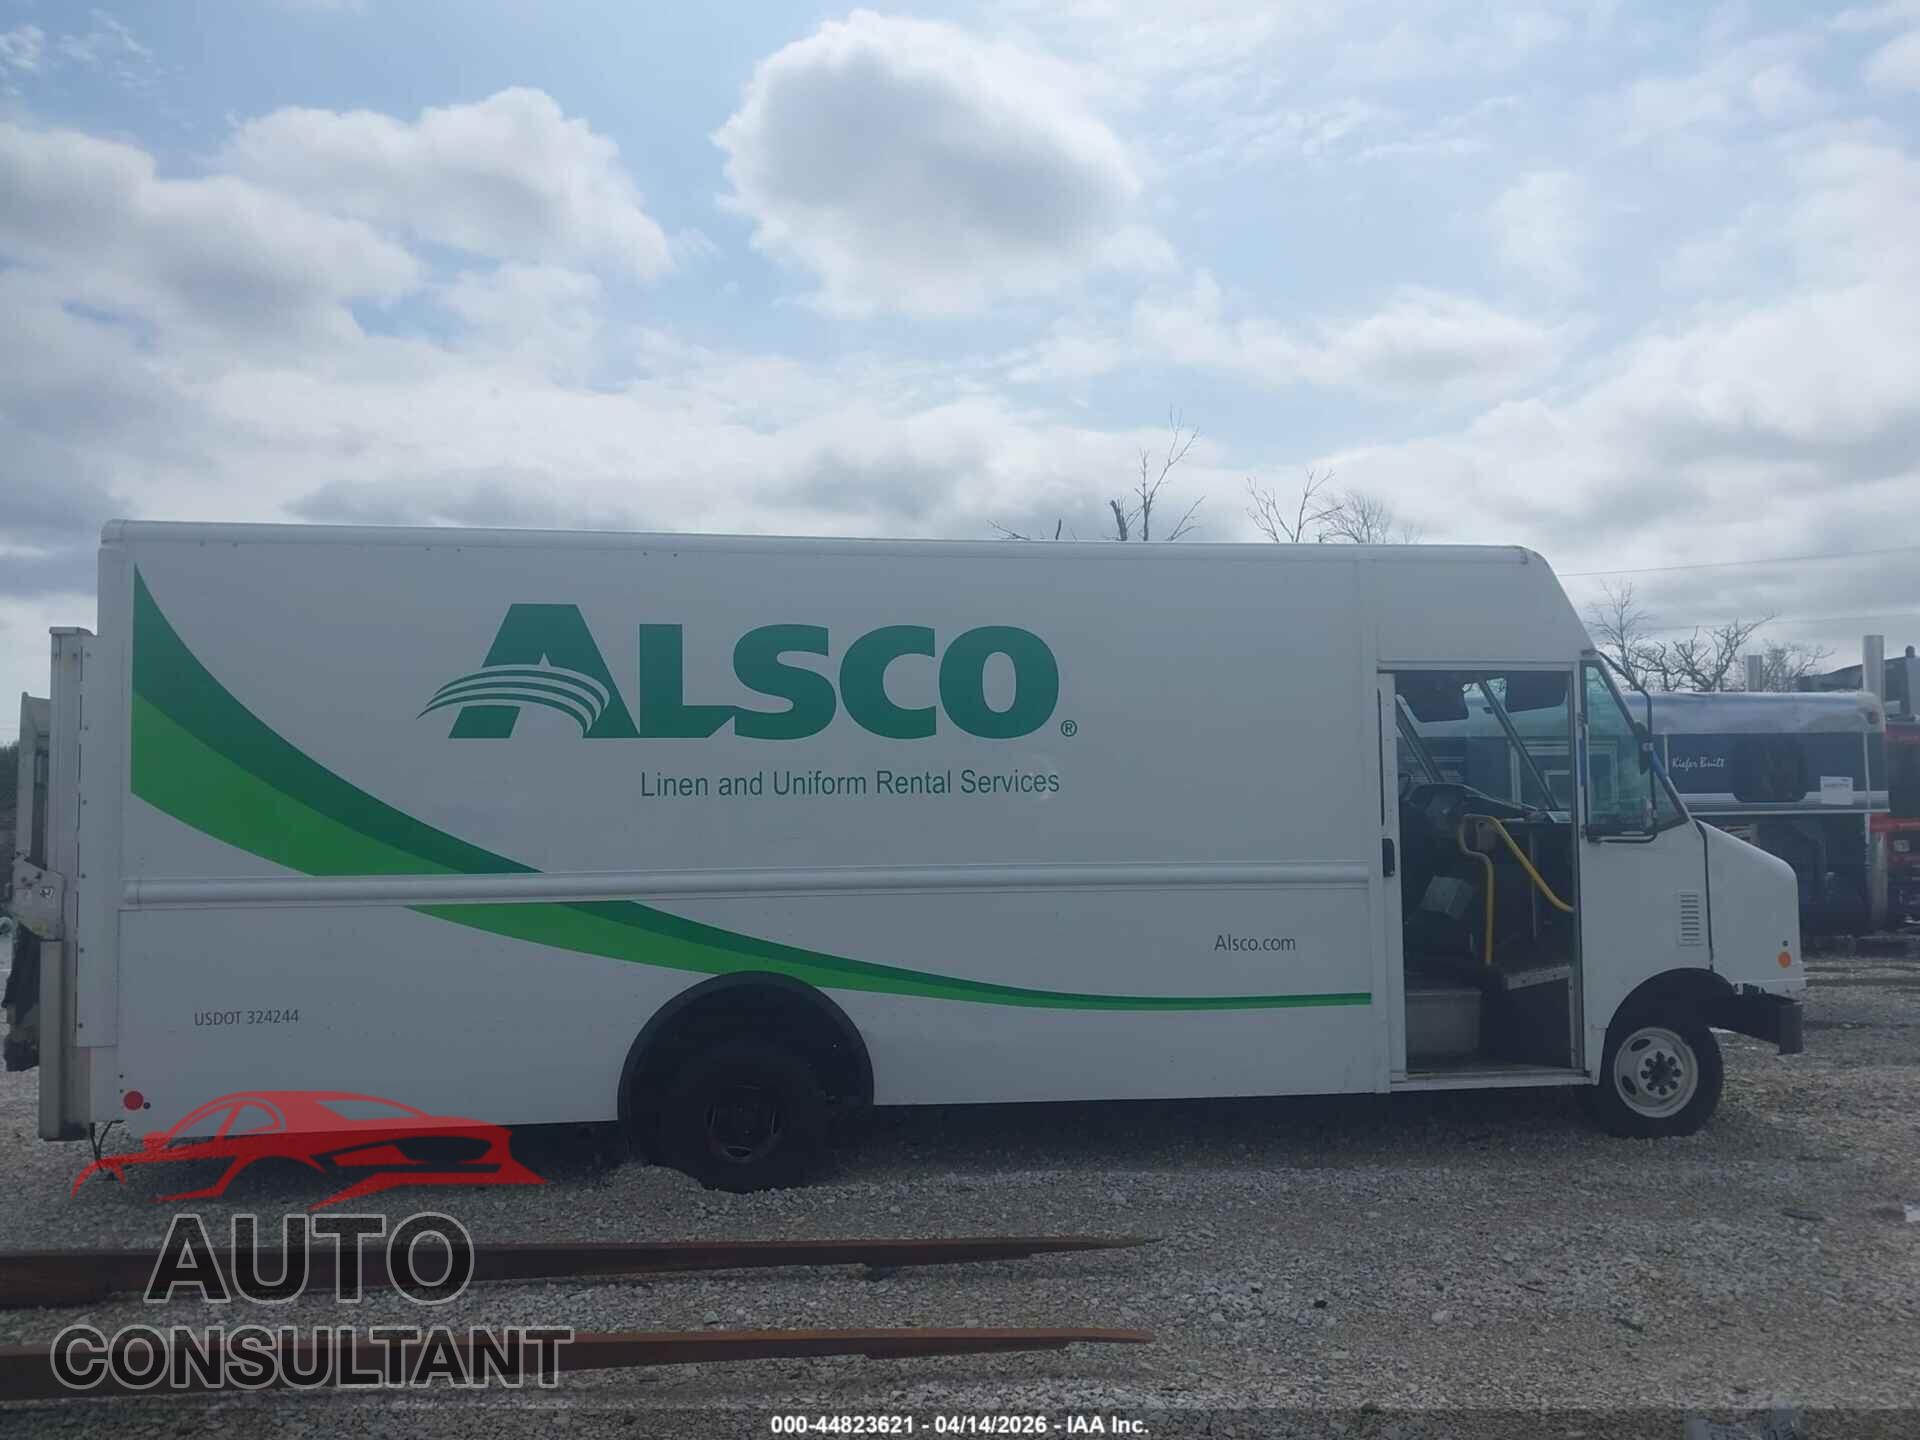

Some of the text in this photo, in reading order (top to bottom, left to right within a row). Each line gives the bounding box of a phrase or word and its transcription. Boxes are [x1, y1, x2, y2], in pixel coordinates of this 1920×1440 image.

[416, 603, 1060, 741] ALSCO
[640, 768, 1060, 798] Linen and Uniform Rental Services
[1214, 934, 1296, 952] Alsco.com
[194, 1009, 299, 1026] USDOT 324244
